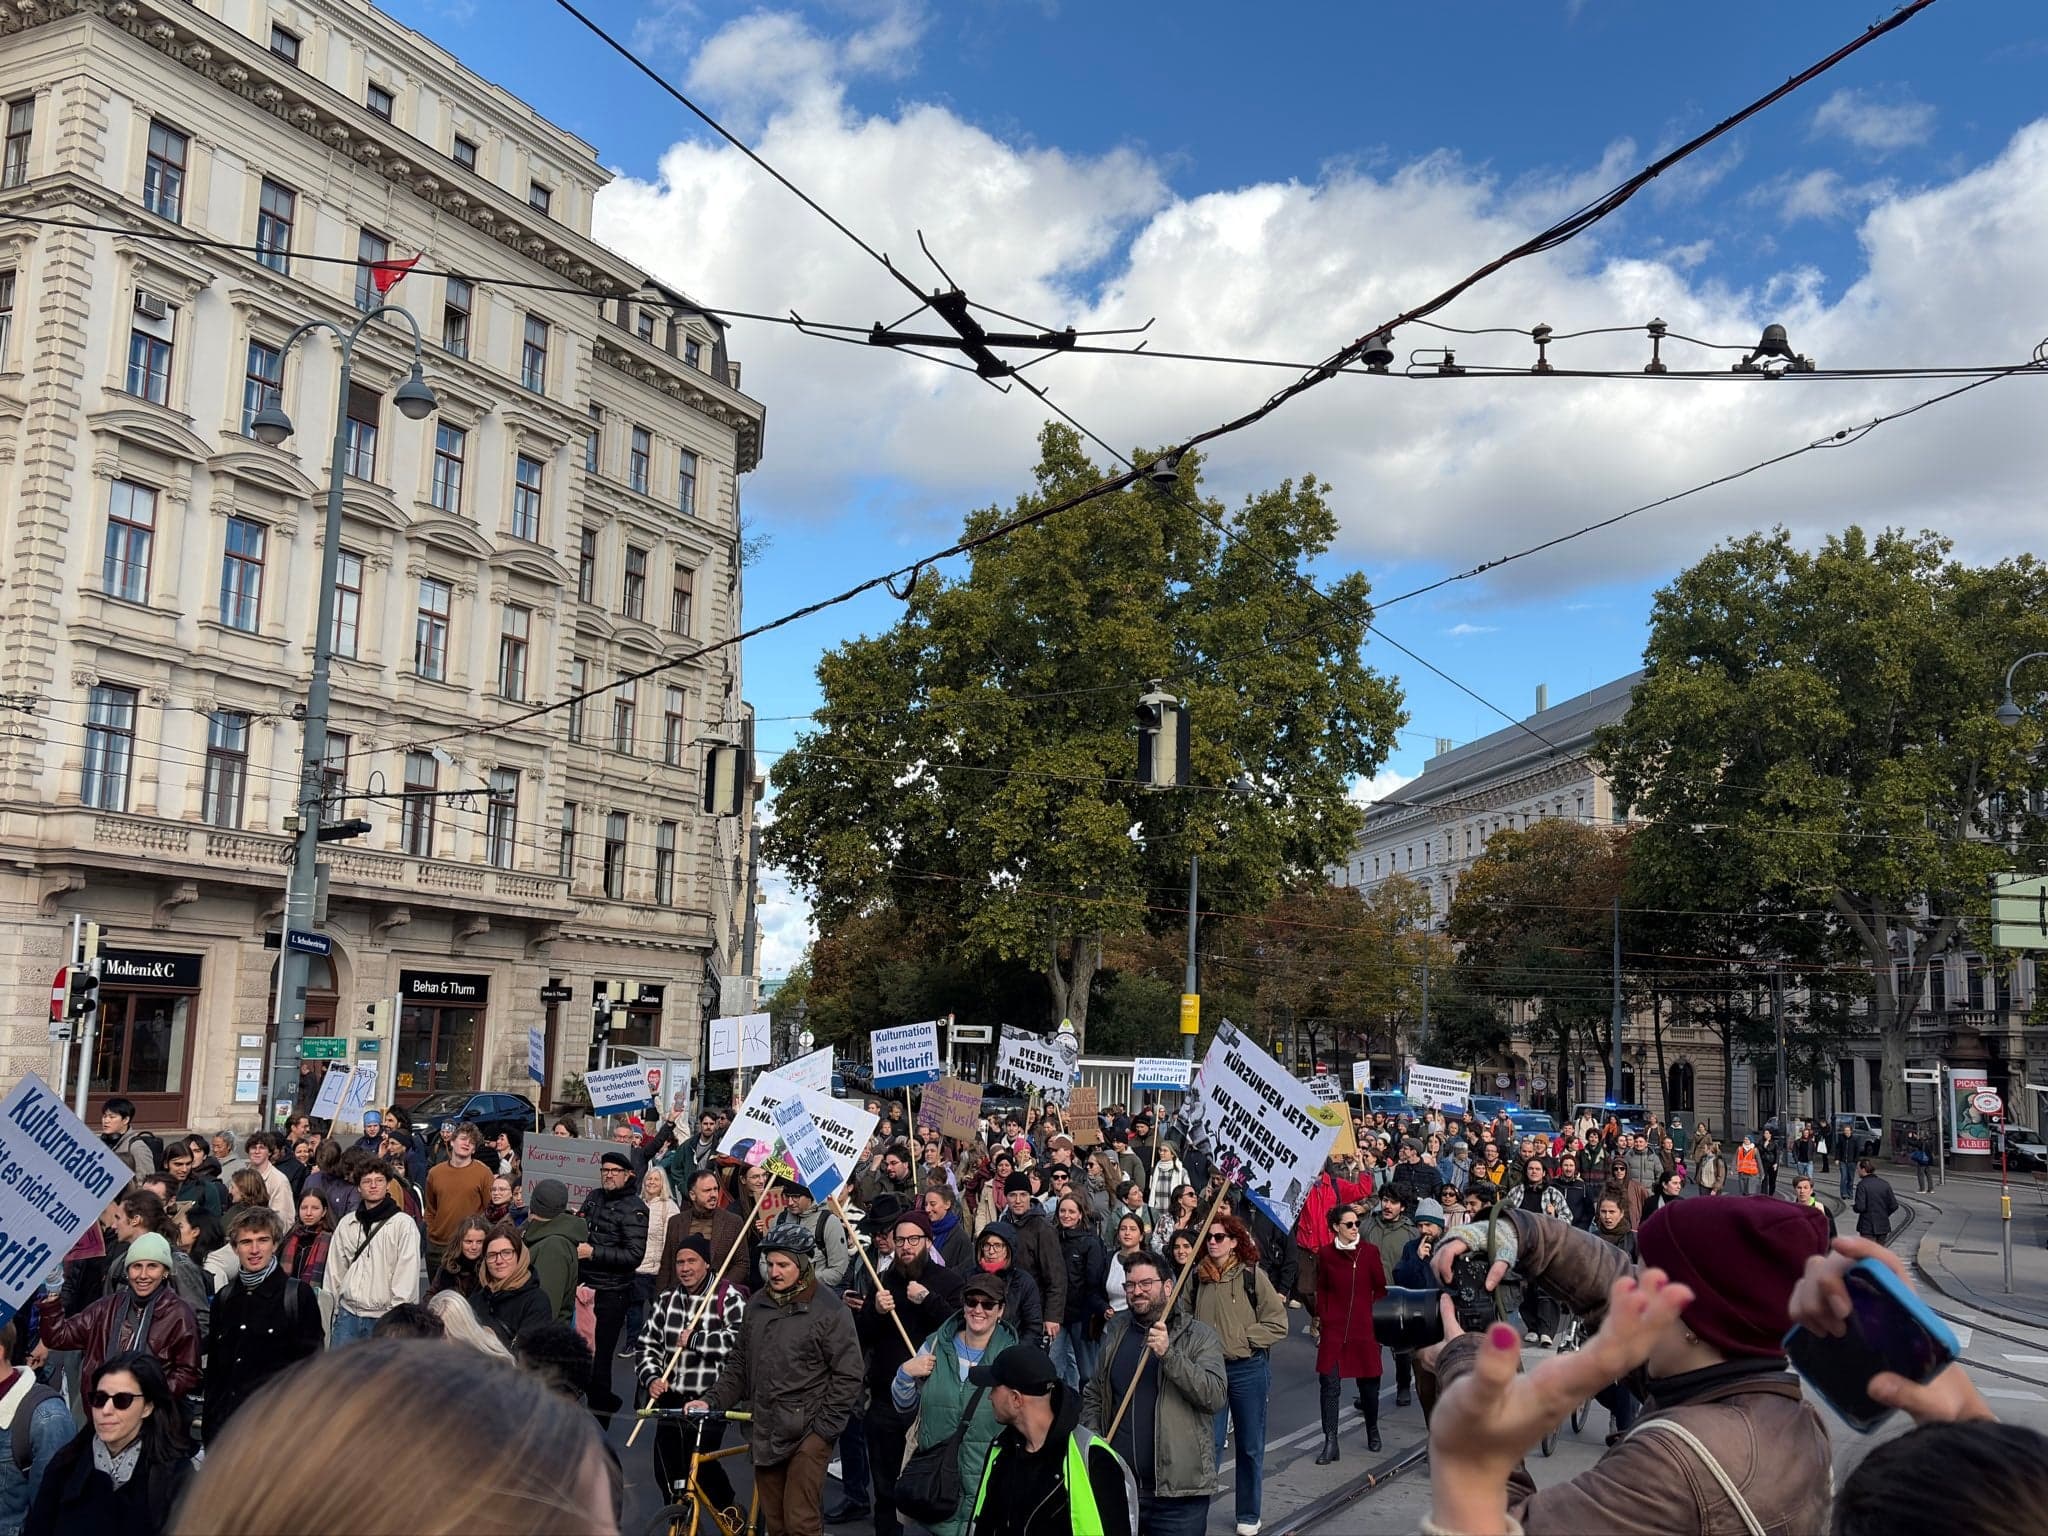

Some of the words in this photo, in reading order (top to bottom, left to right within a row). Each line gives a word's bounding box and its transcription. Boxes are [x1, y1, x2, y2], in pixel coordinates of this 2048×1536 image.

[106, 959, 175, 978] Molteni&C
[413, 979, 439, 994] Behan
[440, 982, 449, 994] &
[450, 983, 475, 996] Thurm
[875, 1025, 931, 1042] Kulturnation
[876, 1046, 890, 1056] gibt
[899, 1042, 917, 1051] nicht
[917, 1040, 933, 1048] zum
[1019, 1047, 1036, 1061] BYE
[1036, 1051, 1056, 1068] BYE,
[878, 1051, 934, 1074] Nulltarif!
[1008, 1056, 1064, 1082] WELTSPITZE!
[1138, 1059, 1188, 1067] Kulturnation
[587, 1067, 642, 1084] Bildungspolitik
[1137, 1073, 1186, 1083] Nulltarif!
[590, 1086, 602, 1094] für
[602, 1079, 645, 1092] schlechtere
[606, 1091, 635, 1102] Schulen
[1223, 1050, 1286, 1111] KÜRZUNGEN
[1282, 1104, 1321, 1141] JETZT
[819, 1119, 855, 1144] KÜRZT,
[1211, 1085, 1299, 1170] KULTURVERLUST
[8, 1086, 115, 1199] Kulturnation
[1219, 1115, 1243, 1143] FÜR
[1239, 1135, 1276, 1174] IMMER
[1, 1161, 24, 1185] es
[15, 1174, 56, 1214] nicht
[47, 1201, 81, 1235] zum
